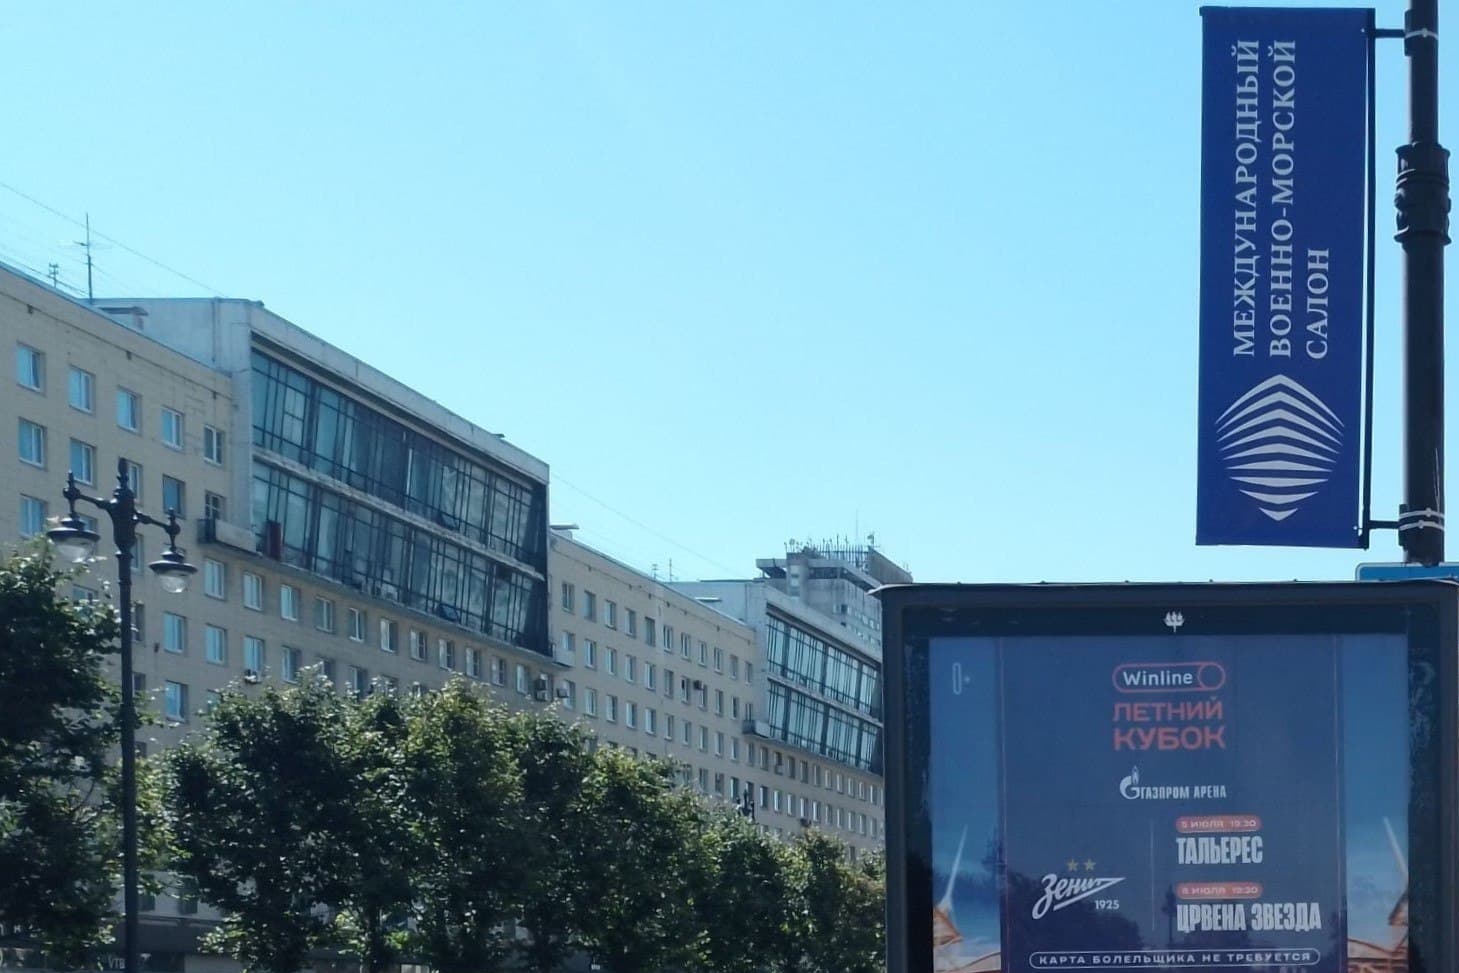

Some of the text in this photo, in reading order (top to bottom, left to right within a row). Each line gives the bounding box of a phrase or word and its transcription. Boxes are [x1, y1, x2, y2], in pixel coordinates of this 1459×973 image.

[1231, 39, 1260, 358] МЕЖДУНАРОДНЫЙ
[1267, 39, 1296, 360] ВОЕННО-МОРСКОЙ
[1305, 247, 1330, 361] САЛОН
[1123, 670, 1194, 687] Winline
[1112, 695, 1223, 722] ЛЕТНИЙ
[1113, 725, 1226, 751] КУБОК
[1140, 784, 1228, 800] ГАЗПРОМ АРЕНА
[1176, 836, 1264, 865] ТАЛЬЕРЕС
[1095, 899, 1120, 911] 1925
[1176, 902, 1322, 933] ЦРВЕНА ЗВЕЗДА
[1039, 951, 1311, 966] КАРТА БОЛЕЛЬЩИКА НЕ ТРЕБУЕТСЯ
